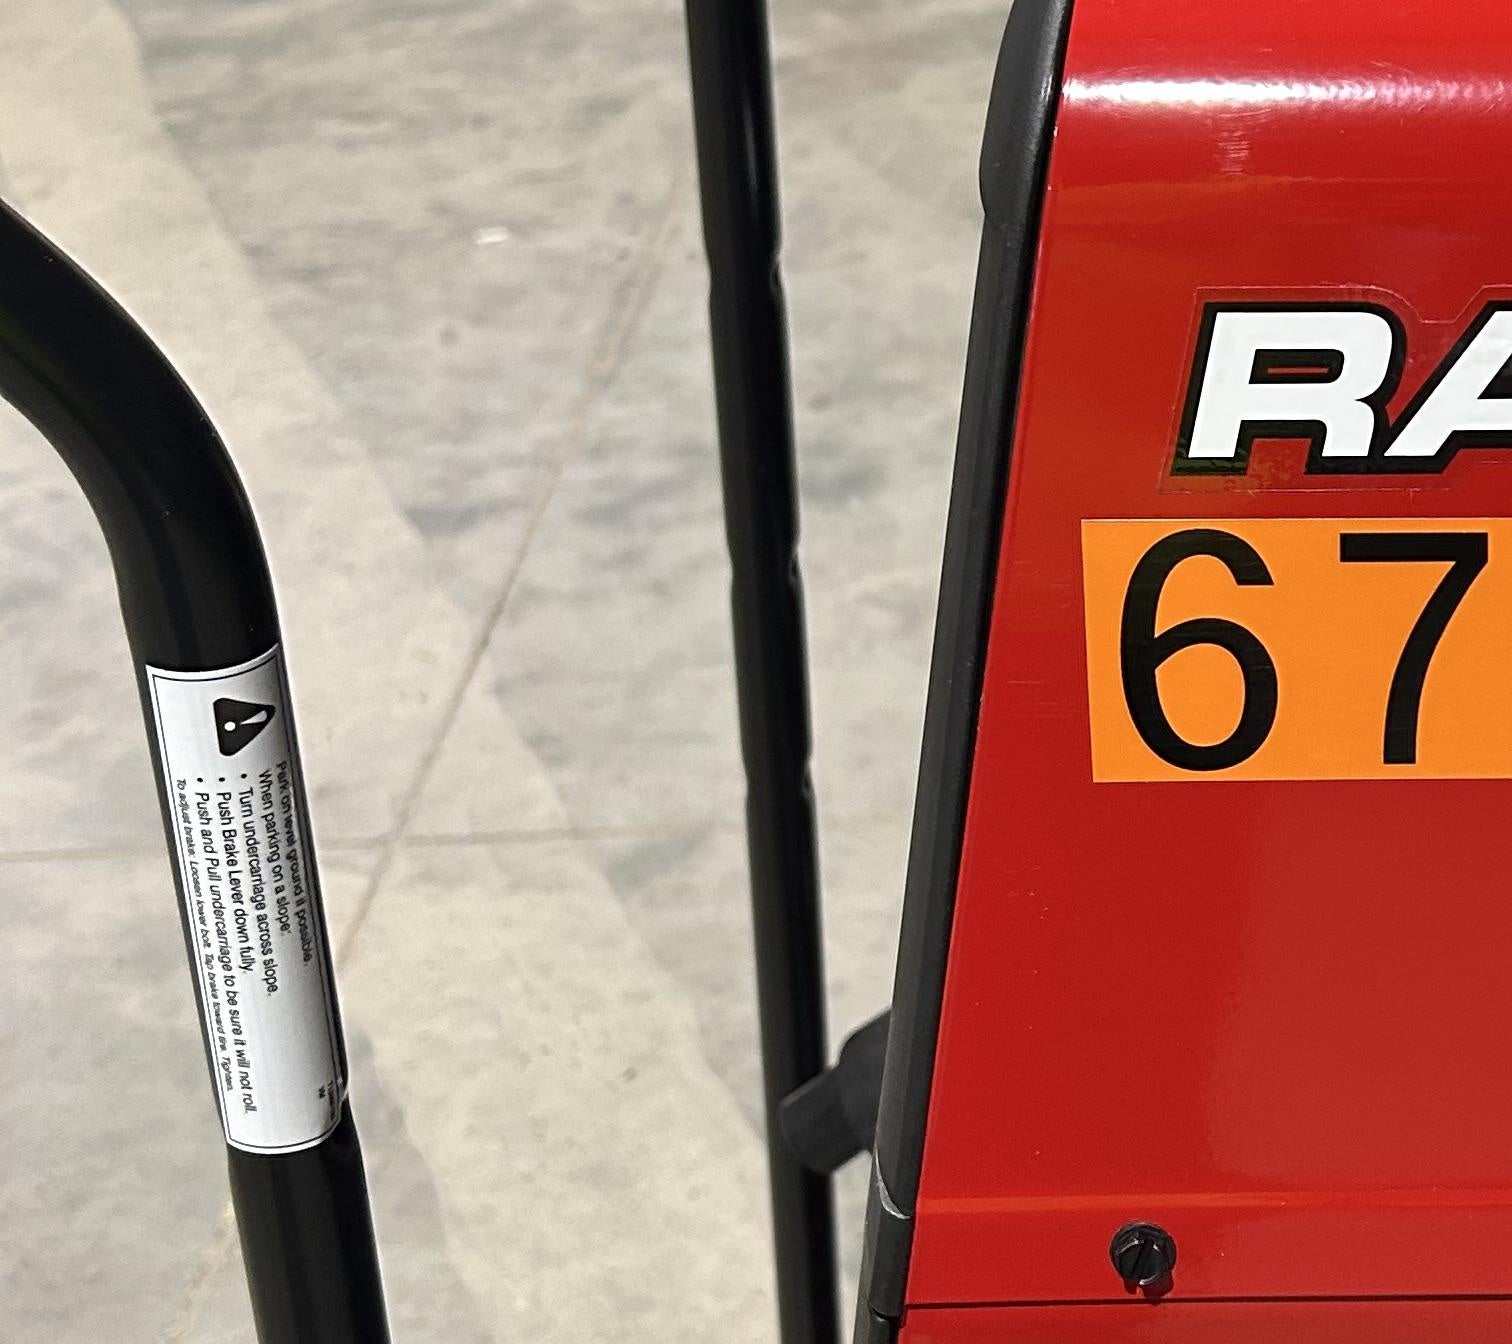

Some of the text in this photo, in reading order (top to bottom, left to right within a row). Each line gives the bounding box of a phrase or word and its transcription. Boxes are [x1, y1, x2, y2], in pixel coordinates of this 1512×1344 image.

[177, 778, 187, 791] To
[258, 769, 274, 810] When
[277, 761, 290, 794] Park
[178, 792, 192, 825] adjust
[217, 791, 235, 826] Push
[281, 795, 292, 813] on
[222, 828, 240, 867] Brake
[261, 812, 281, 863] parking
[189, 860, 203, 897] Loosen
[228, 870, 244, 905] Lever
[271, 864, 284, 883] on
[275, 885, 285, 895] a
[286, 849, 306, 896] ground
[238, 787, 279, 996] Turn undercarriage across slope.
[234, 908, 250, 943] down
[195, 792, 258, 1113] Push and Pull undercarriage to be sure it will not roll.
[204, 953, 215, 970] Tap
[207, 971, 219, 1000] brake
